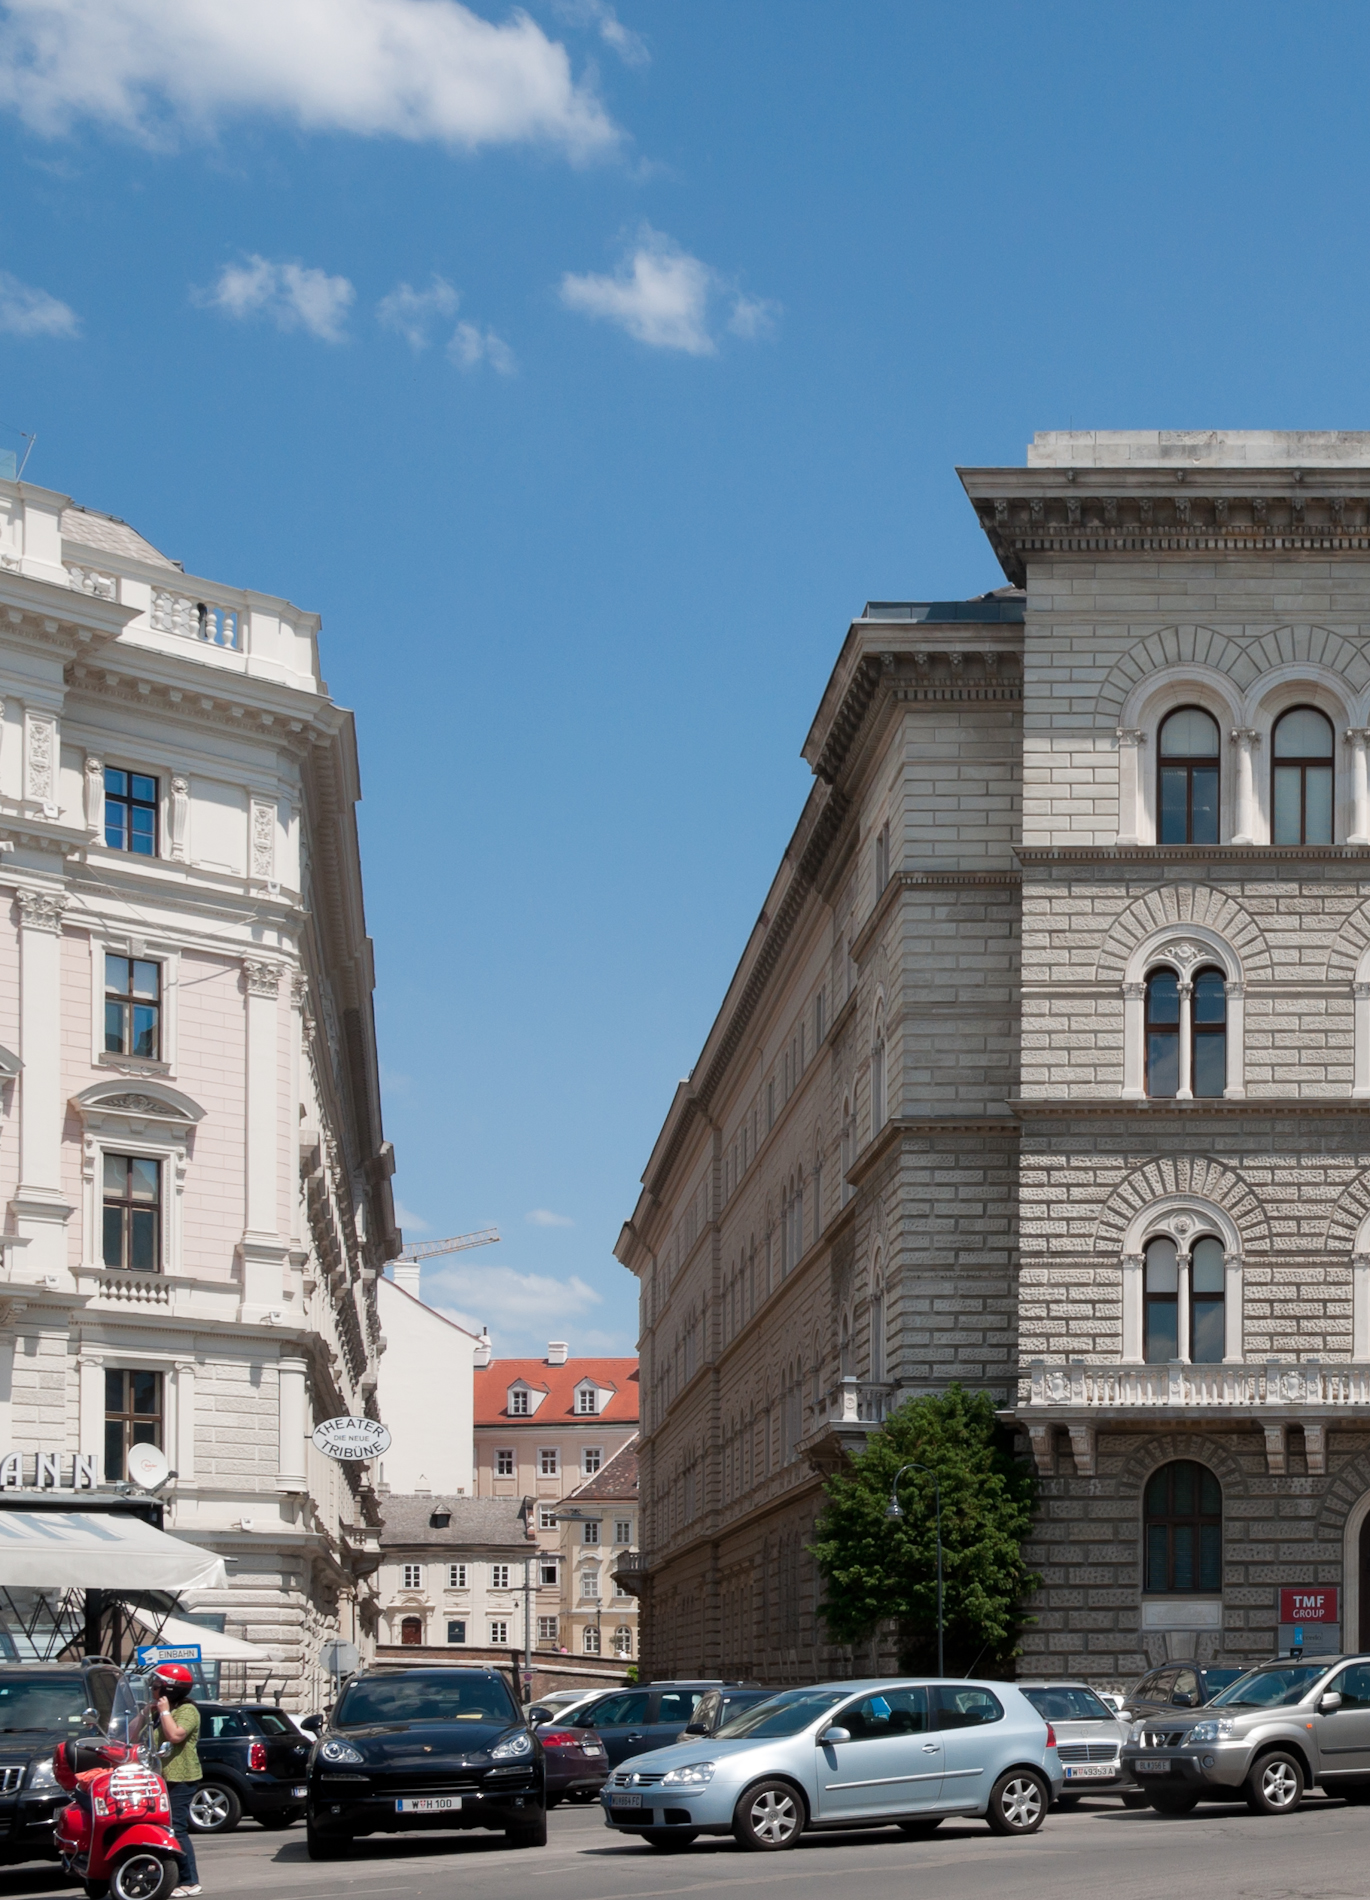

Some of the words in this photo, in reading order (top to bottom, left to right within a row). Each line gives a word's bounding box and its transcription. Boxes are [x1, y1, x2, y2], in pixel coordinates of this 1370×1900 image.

[315, 1418, 385, 1438] THEATER
[321, 1439, 384, 1458] TRIBÜNE
[0, 1451, 98, 1489] ANN
[1292, 1595, 1325, 1608] TMF
[1292, 1609, 1325, 1618] GROUP
[159, 1650, 195, 1659] EINBAHN
[412, 1800, 419, 1809] W
[436, 1799, 452, 1808] 100
